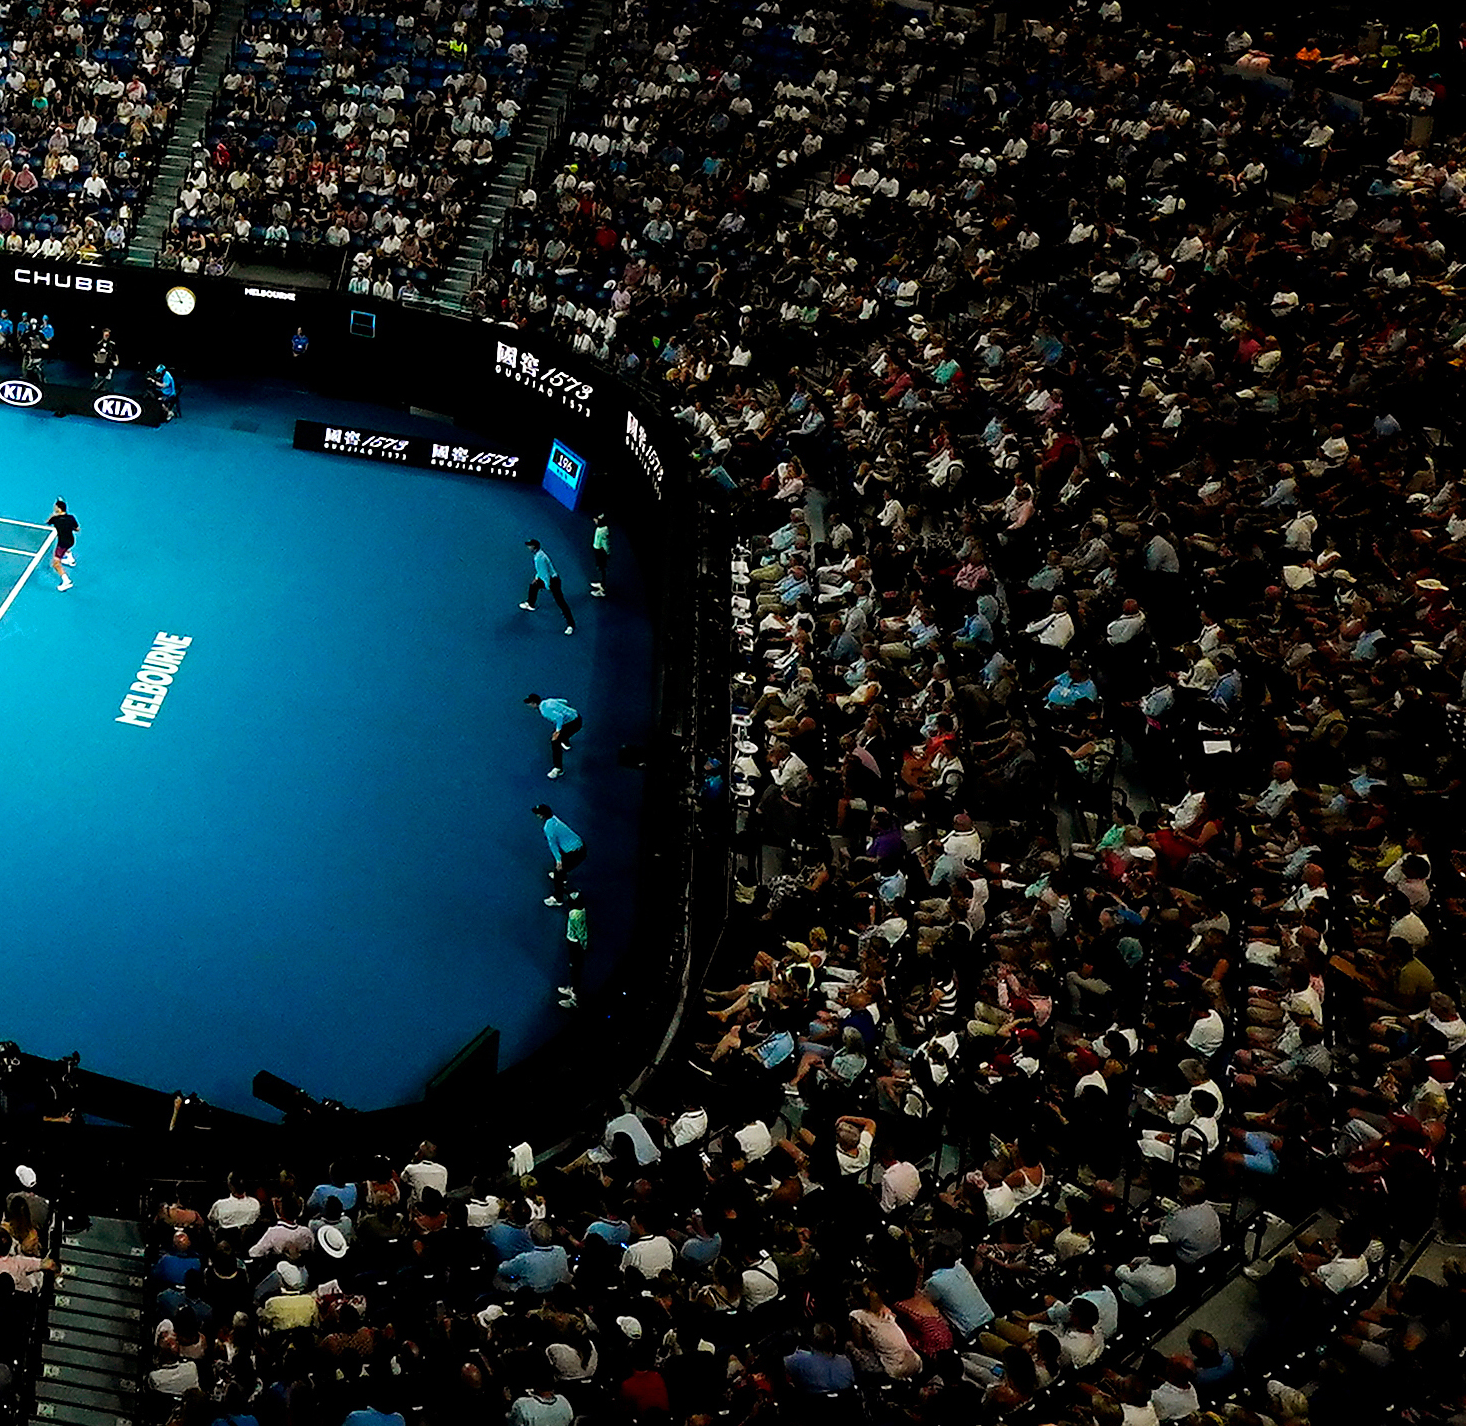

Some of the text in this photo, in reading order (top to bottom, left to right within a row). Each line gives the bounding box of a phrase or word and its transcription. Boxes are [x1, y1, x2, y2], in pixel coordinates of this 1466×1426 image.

[14, 268, 114, 294] CHUBB
[3, 384, 34, 402] KIA
[102, 399, 133, 417] KIA
[558, 454, 573, 473] 196
[114, 631, 193, 729] MELBOURNE
